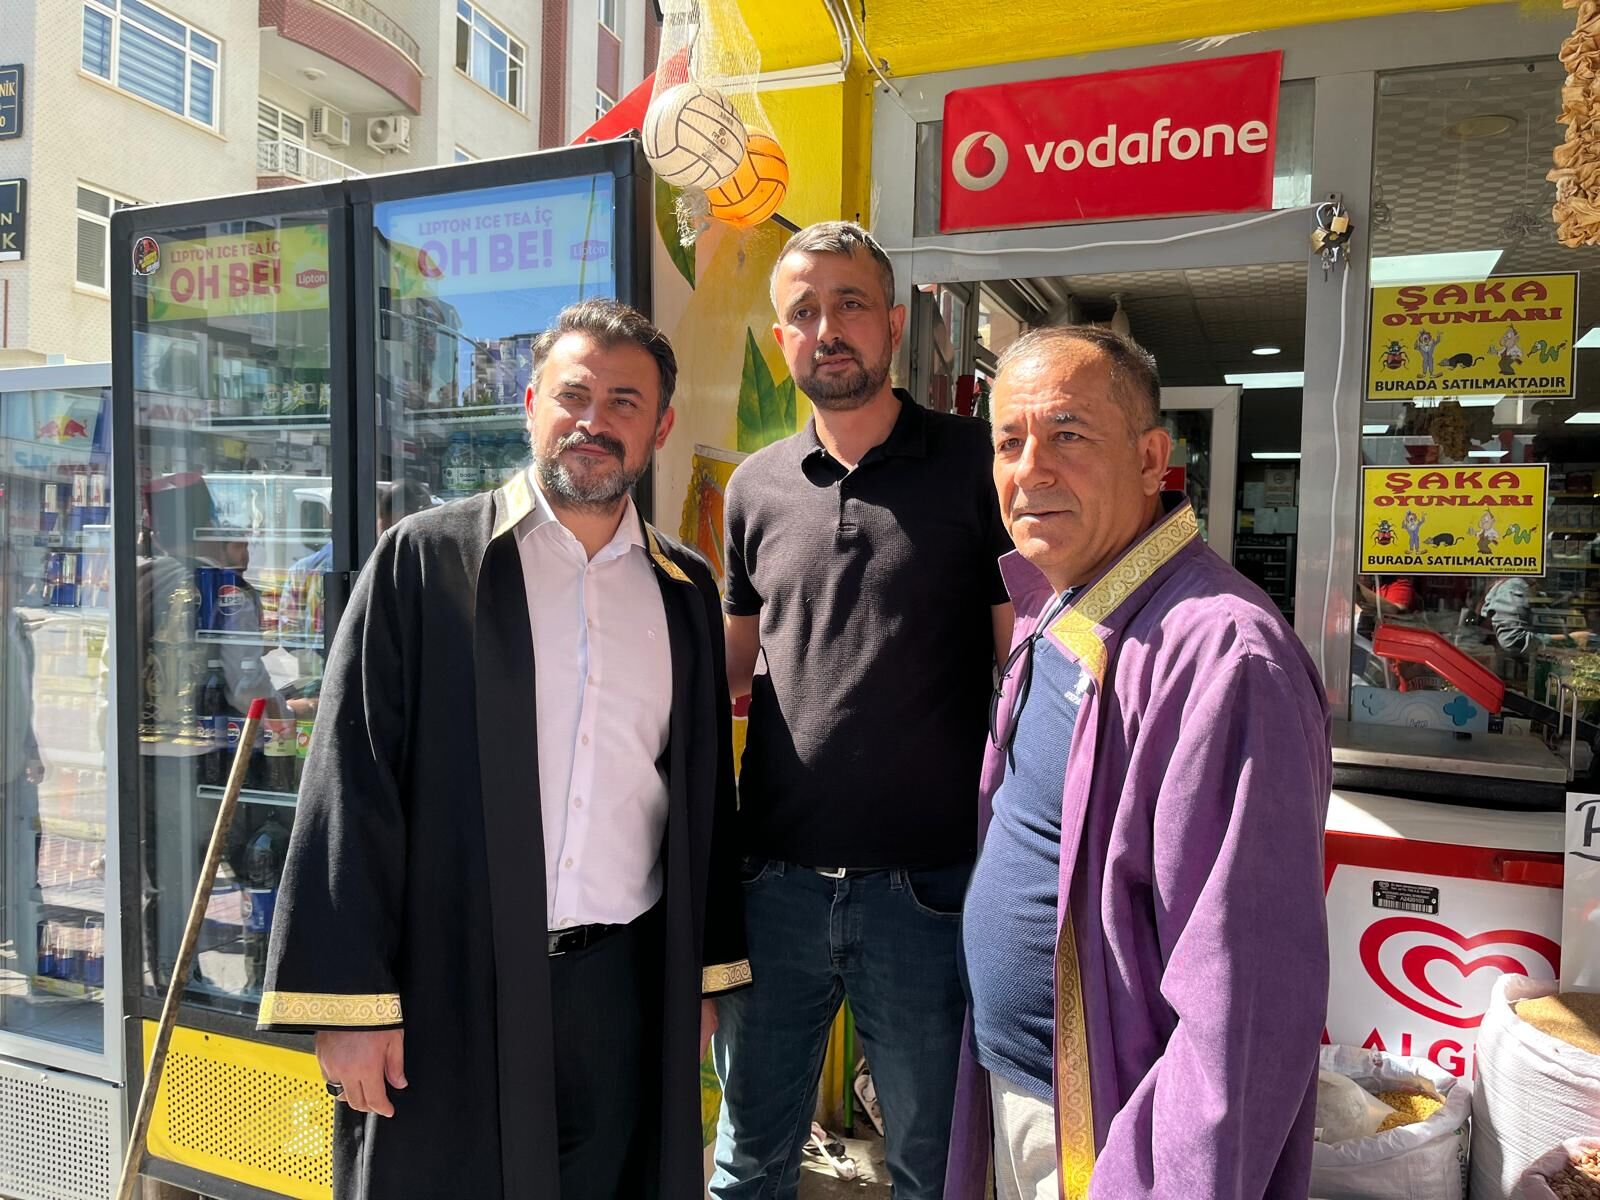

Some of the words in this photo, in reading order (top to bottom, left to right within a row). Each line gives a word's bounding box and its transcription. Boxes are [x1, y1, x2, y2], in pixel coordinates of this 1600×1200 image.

[1025, 118, 1268, 173] vodafone
[418, 218, 471, 236] LIPTON
[475, 214, 500, 231] ICE
[504, 211, 531, 227] TEA
[535, 206, 553, 227] İÇ
[2, 232, 17, 249] K
[170, 247, 214, 263] LIPTON
[217, 244, 238, 259] ICE
[241, 242, 263, 257] TEA
[417, 236, 478, 279] OH
[489, 229, 553, 273] BE!
[573, 245, 606, 258] Lipton
[169, 264, 220, 303] OH
[229, 258, 281, 298] BE!
[298, 273, 326, 286] Lipton
[1396, 281, 1548, 312] ŞAKA
[1382, 307, 1563, 326] OYUNLARI
[1375, 379, 1437, 392] BURADA
[1441, 376, 1565, 390] SATILMAKTADIR
[1385, 471, 1520, 494] ŞAKA
[1373, 495, 1533, 507] OYUNLARI
[1368, 555, 1424, 566] BURADA
[1427, 555, 1537, 567] SATILMAKTADIR
